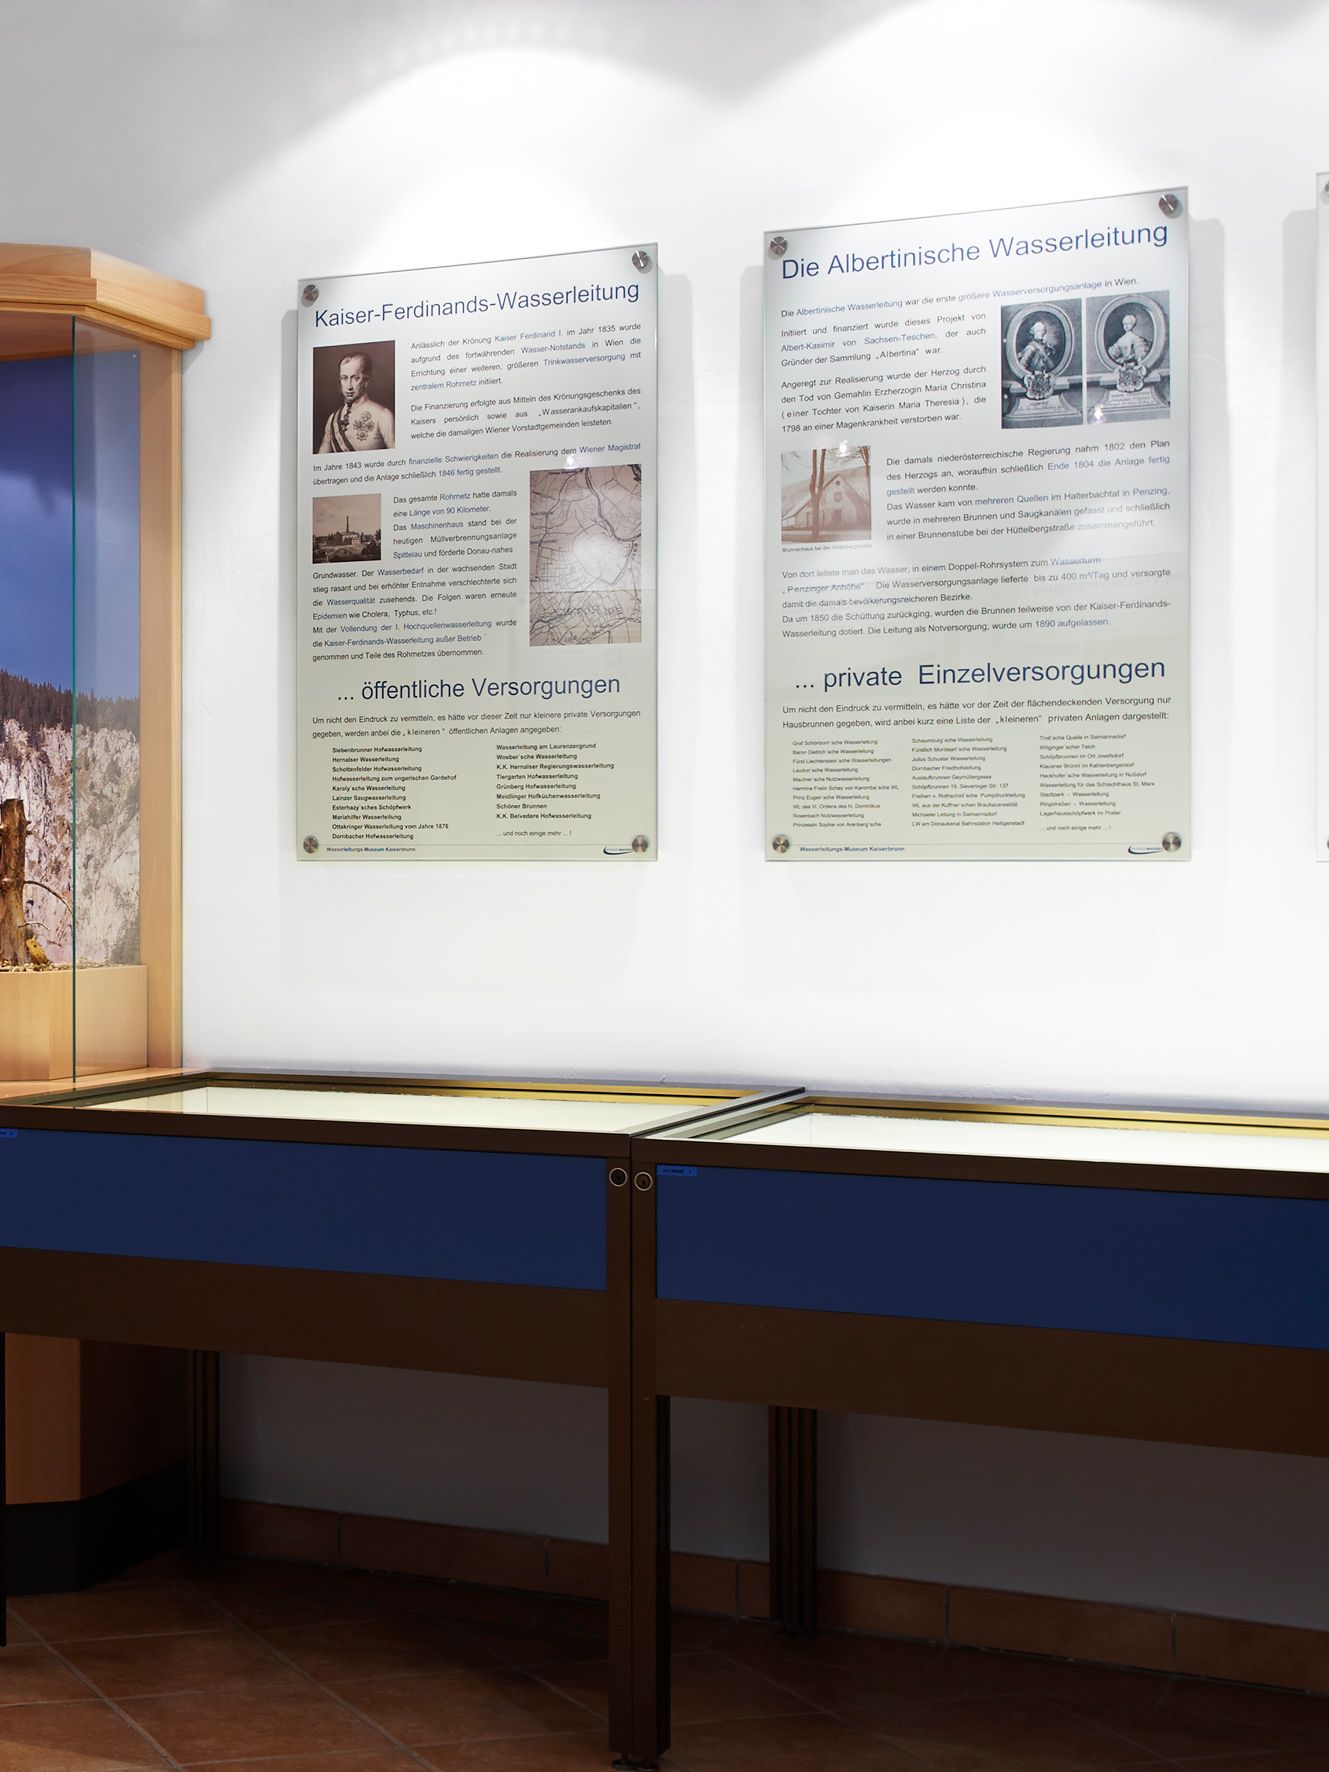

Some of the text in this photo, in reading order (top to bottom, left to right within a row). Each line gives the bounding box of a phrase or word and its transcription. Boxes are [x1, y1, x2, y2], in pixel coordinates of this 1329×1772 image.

[782, 225, 1167, 279] Die Albertinische Wasserleitung
[314, 283, 639, 328] Kaiser-Ferdinands-Wasserleitung
[780, 308, 795, 319] Die
[795, 305, 846, 316] Albertinische
[847, 300, 903, 311] Wasserleitung
[904, 298, 920, 306] war
[935, 295, 956, 303] erste
[958, 291, 990, 303] größere
[992, 281, 1102, 297] Wasserversorgungsanlage
[1104, 279, 1113, 287] in
[410, 340, 445, 349] Anlässlich
[447, 339, 460, 347] der
[462, 337, 492, 345] Krönung
[494, 334, 517, 342] Kaiser
[520, 330, 556, 340] Ferdinand
[578, 327, 595, 335] Jahr
[598, 324, 616, 334] 1835
[618, 323, 641, 331] wurde
[781, 328, 807, 338] Initiiert
[812, 326, 828, 335] und
[832, 322, 869, 333] finanziert
[874, 320, 899, 329] wurde
[904, 318, 931, 327] dieses
[936, 314, 965, 324] Projekt
[410, 354, 441, 365] aufgrund
[446, 353, 460, 361] des
[465, 348, 515, 359] fortwährenden
[520, 342, 586, 354] Wasser-Notstands
[604, 338, 624, 347] Wien
[629, 337, 641, 345] die
[410, 368, 446, 378] Errichtung
[506, 360, 539, 371] größeren
[543, 353, 626, 366] Trinkwasserversorgung
[629, 351, 641, 359] mit
[781, 365, 986, 390] Angeregt zur Realisierung wurde der Herzog durch
[410, 404, 423, 412] Die
[424, 401, 469, 411] Finanzierung
[470, 399, 496, 408] erfolgte
[512, 395, 537, 404] Mitteln
[538, 394, 552, 402] des
[553, 388, 626, 401] Krönungsgeschenks
[627, 387, 641, 395] des
[781, 381, 986, 404] den Tod von Gemahlin Erzherzogin Maria Christina
[410, 431, 435, 439] welche
[435, 430, 447, 438] die
[447, 428, 484, 437] damaligen
[484, 426, 510, 434] Wiener
[511, 420, 580, 432] Vorstadtgemeinden
[782, 424, 801, 433] 1798
[802, 424, 813, 432] an
[814, 423, 834, 431] einer
[836, 417, 898, 430] Magenkrankheit
[900, 415, 943, 424] verstorben
[886, 439, 1170, 466] Die damals niederösterreichische Regierung nahm 1802 den Plan
[393, 517, 517, 532] Das Maschinenhaus stand bei der
[361, 568, 375, 578] Der
[377, 566, 424, 576] Wasserbedarf
[437, 566, 449, 574] der
[451, 564, 495, 572] wachsenden
[498, 562, 517, 570] Stadt
[361, 679, 465, 700] öffentliche
[471, 677, 620, 700] Versorgungen
[824, 666, 902, 693] private
[919, 661, 1165, 685] Einzelversorgungen
[312, 716, 325, 725] Um
[326, 716, 342, 724] nicht
[358, 715, 388, 723] Eindruck
[400, 714, 435, 722] vermitteln,
[447, 713, 466, 721] hätte
[504, 712, 518, 720] Zeit
[533, 711, 562, 719] kleinere
[563, 711, 588, 720] private
[590, 710, 640, 719] Versorgungen
[782, 706, 796, 714] Um
[798, 705, 817, 713] nicht
[818, 705, 834, 713] den
[835, 704, 870, 712] Eindruck
[883, 702, 925, 711] vermitteln,
[939, 701, 960, 709] hätte
[977, 700, 991, 709] der
[993, 699, 1009, 708] Zeit
[1010, 700, 1025, 708] der
[1026, 697, 1102, 707] flächendeckenden
[1104, 696, 1154, 706] Versorgung
